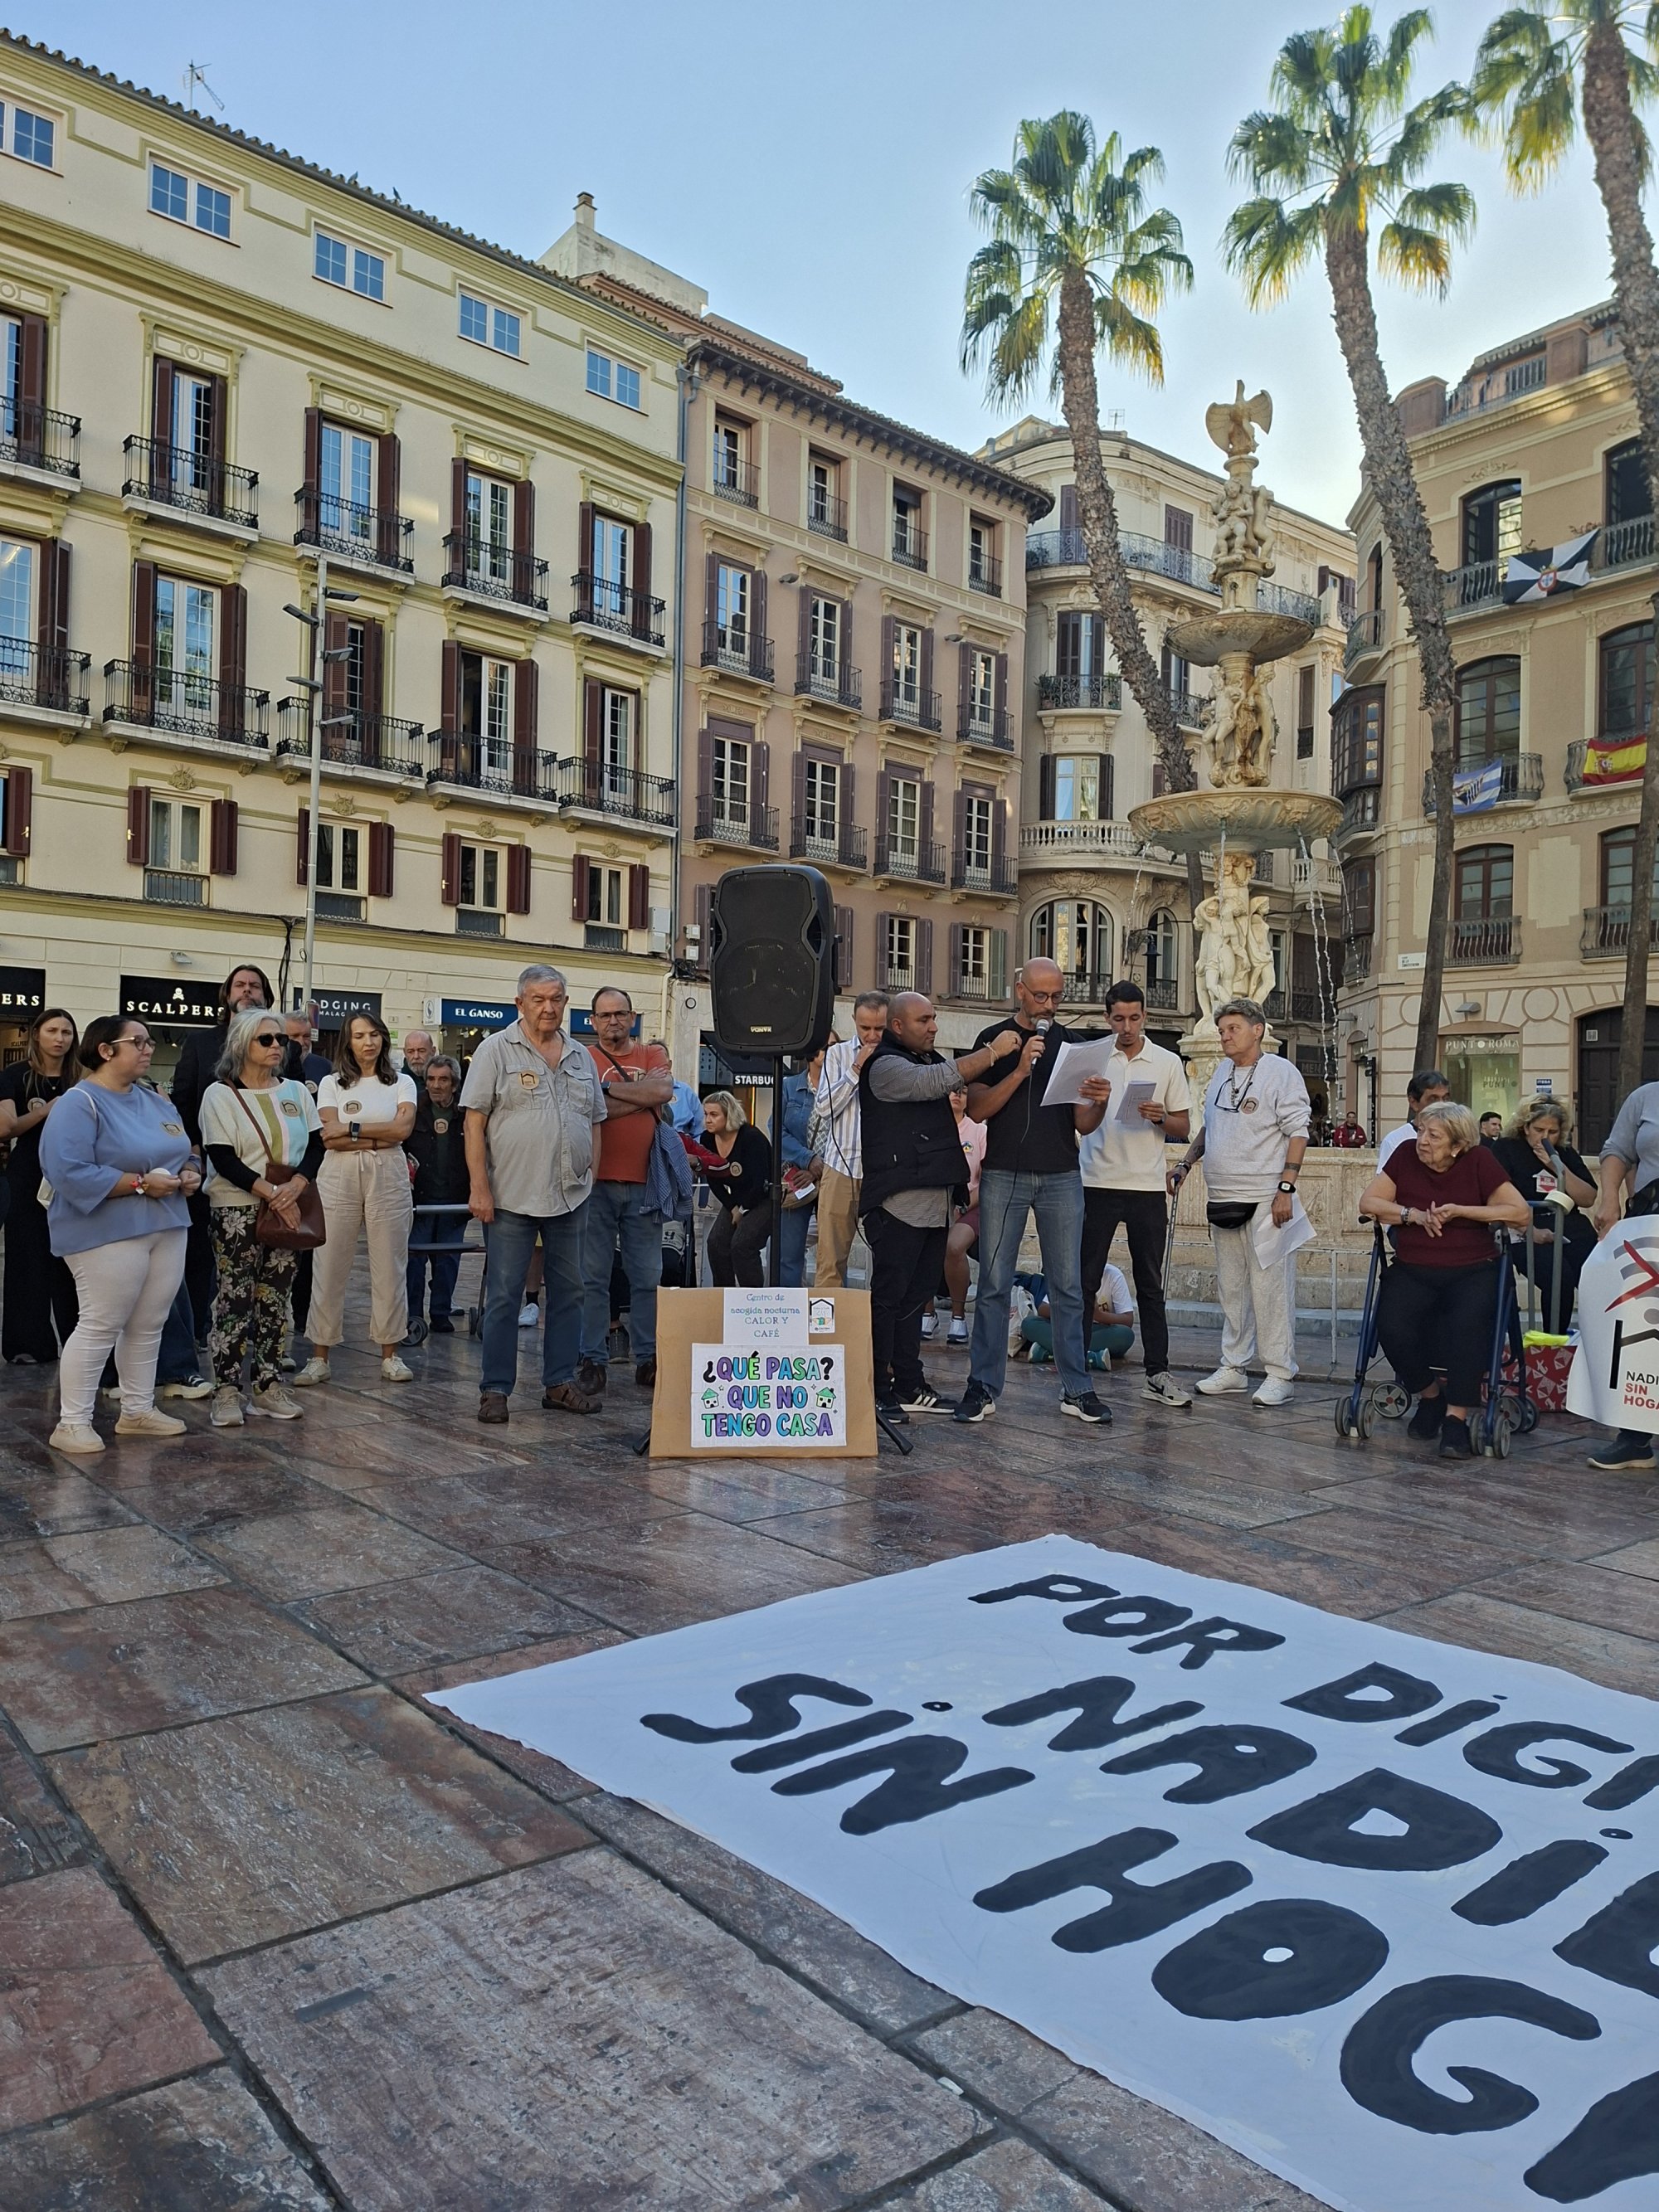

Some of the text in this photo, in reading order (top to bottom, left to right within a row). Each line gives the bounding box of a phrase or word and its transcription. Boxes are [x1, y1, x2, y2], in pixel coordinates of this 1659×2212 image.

[1, 993, 41, 1007] ERS
[455, 1007, 504, 1019] EL GANSO
[734, 1075, 774, 1085] STARBU
[746, 1293, 785, 1302] Centro de
[730, 1306, 800, 1315] acogida nocturna
[744, 1316, 790, 1325] CALOR Y
[753, 1329, 780, 1339] CAFÉ
[703, 1350, 834, 1383] ¿QUÉ PASA?
[1625, 1383, 1648, 1396] SIN
[727, 1385, 809, 1411] QUE NO
[701, 1412, 834, 1438] TENGO CASA
[968, 1573, 1287, 1670] POR
